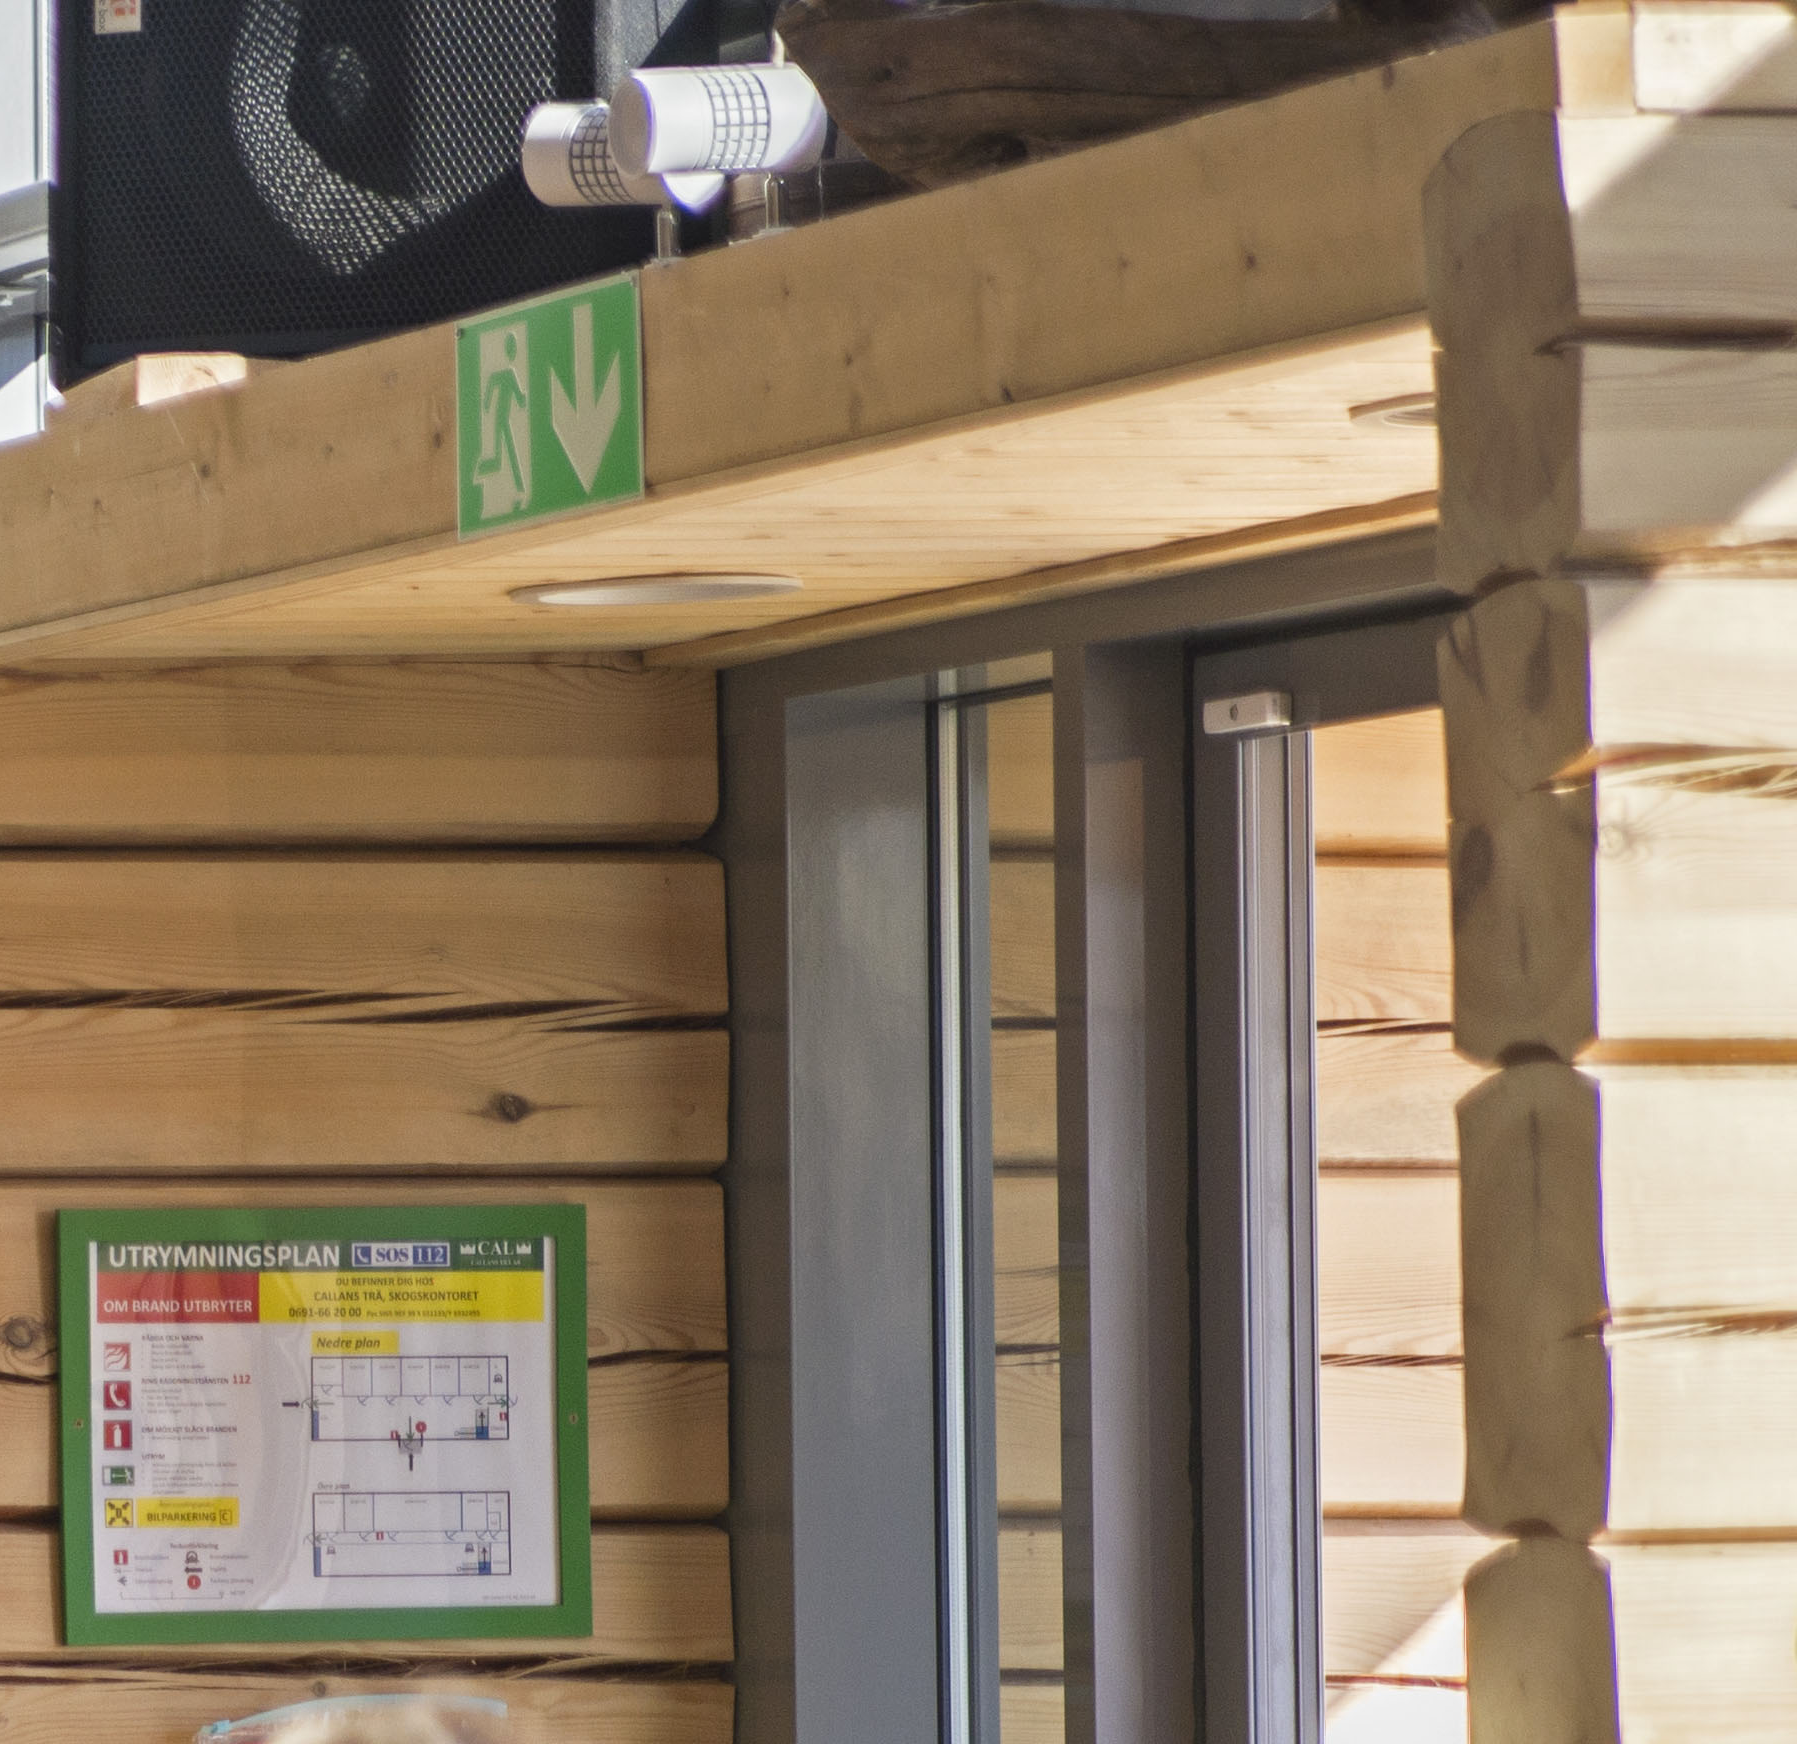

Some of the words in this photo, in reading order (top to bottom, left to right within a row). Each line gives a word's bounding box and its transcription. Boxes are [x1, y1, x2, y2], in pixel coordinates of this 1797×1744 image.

[375, 1247, 409, 1263] SOS
[417, 1247, 445, 1263] 112
[477, 1240, 515, 1257] CAL
[108, 1245, 340, 1268] UTRYMNINGSPLAN
[313, 1291, 360, 1302] CALLANS
[389, 1290, 480, 1302] SKOGSKONTORET
[104, 1300, 129, 1313] OM
[132, 1300, 180, 1313] BRAND
[183, 1299, 253, 1313] UTBRYTER
[348, 1307, 362, 1318] 00
[316, 1336, 353, 1349] Nedre
[354, 1336, 381, 1351] plan
[232, 1373, 252, 1385] 112
[146, 1512, 217, 1522] BILPARKERING
